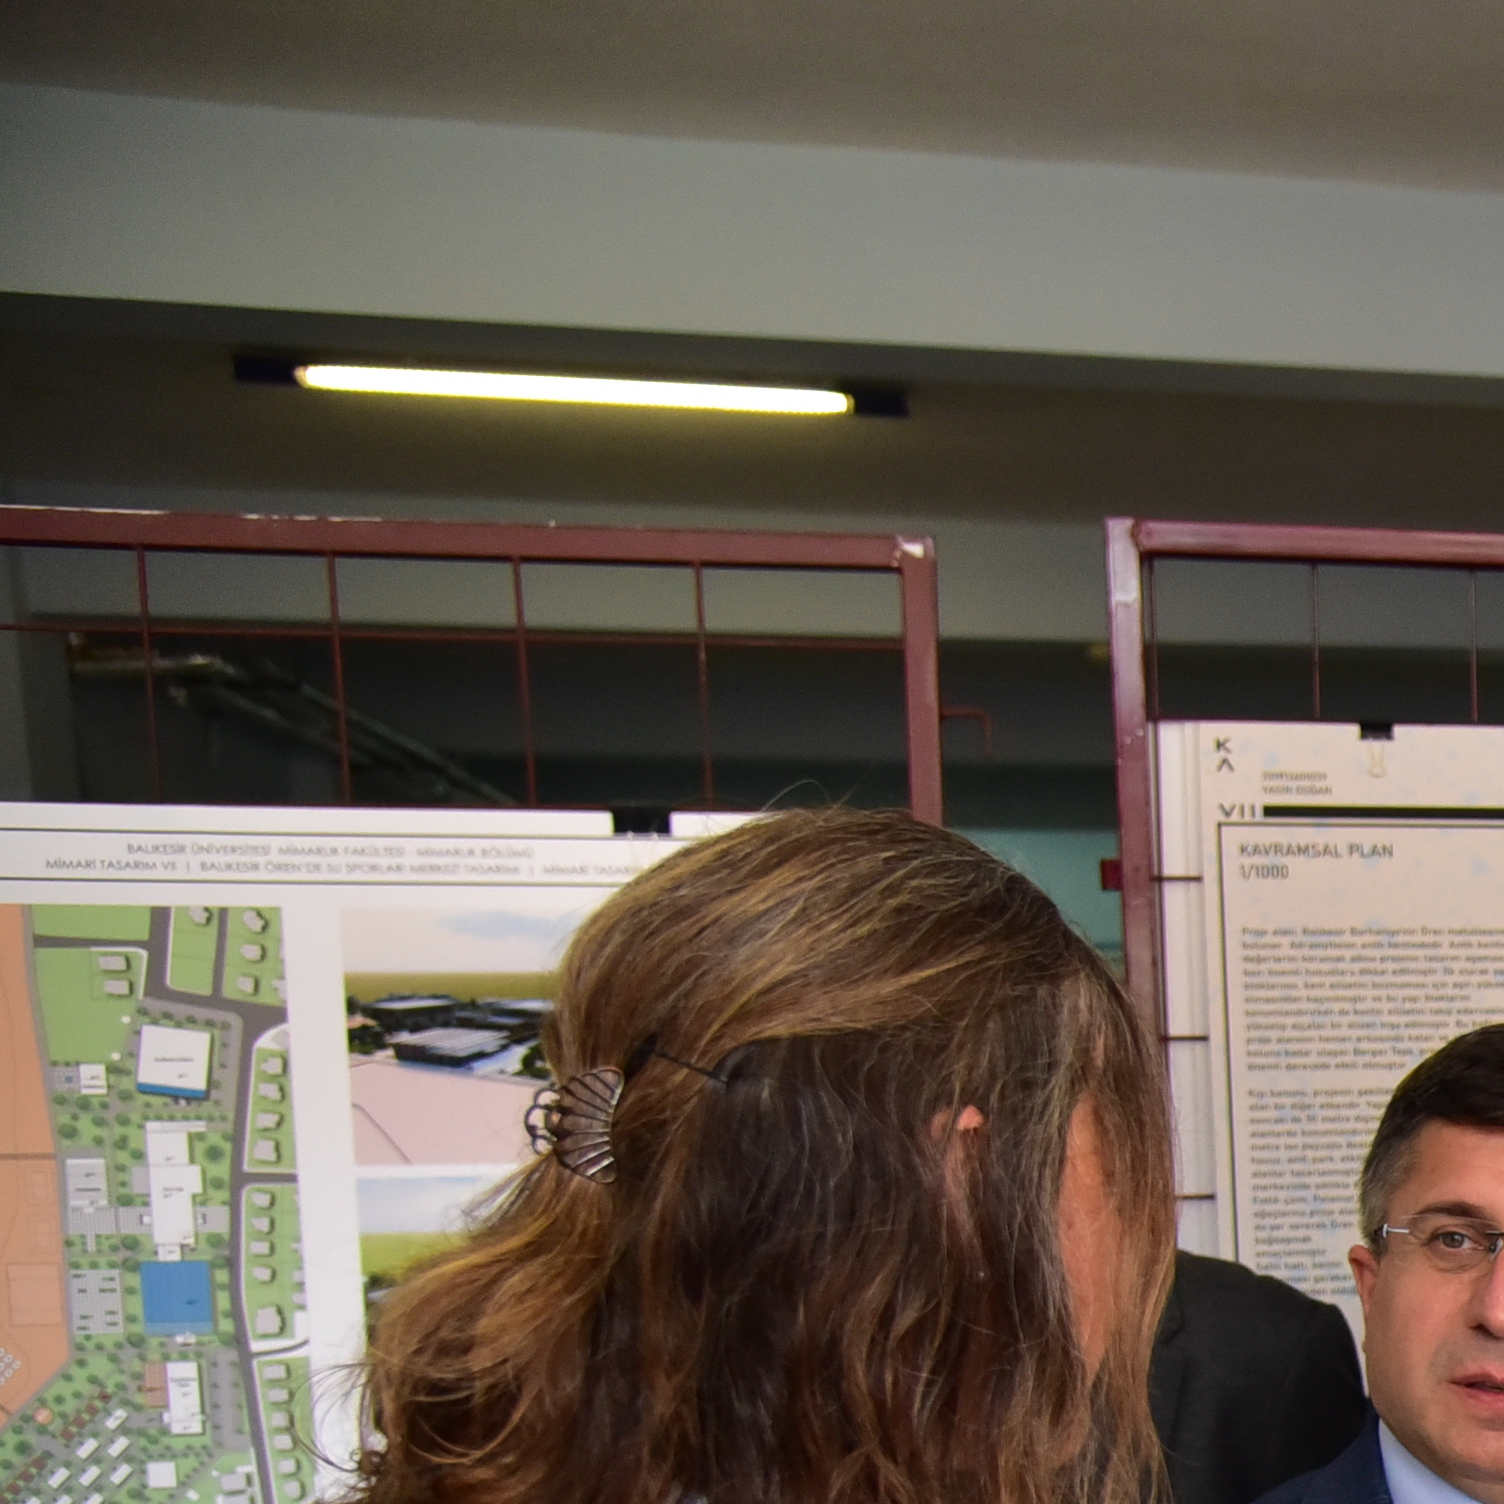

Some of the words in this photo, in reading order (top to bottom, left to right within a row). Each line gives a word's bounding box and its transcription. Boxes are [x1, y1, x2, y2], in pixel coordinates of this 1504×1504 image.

[1239, 842, 1343, 859] KAVRAMSAL
[1347, 843, 1395, 859] PLAN
[1239, 863, 1290, 880] 1/1000
